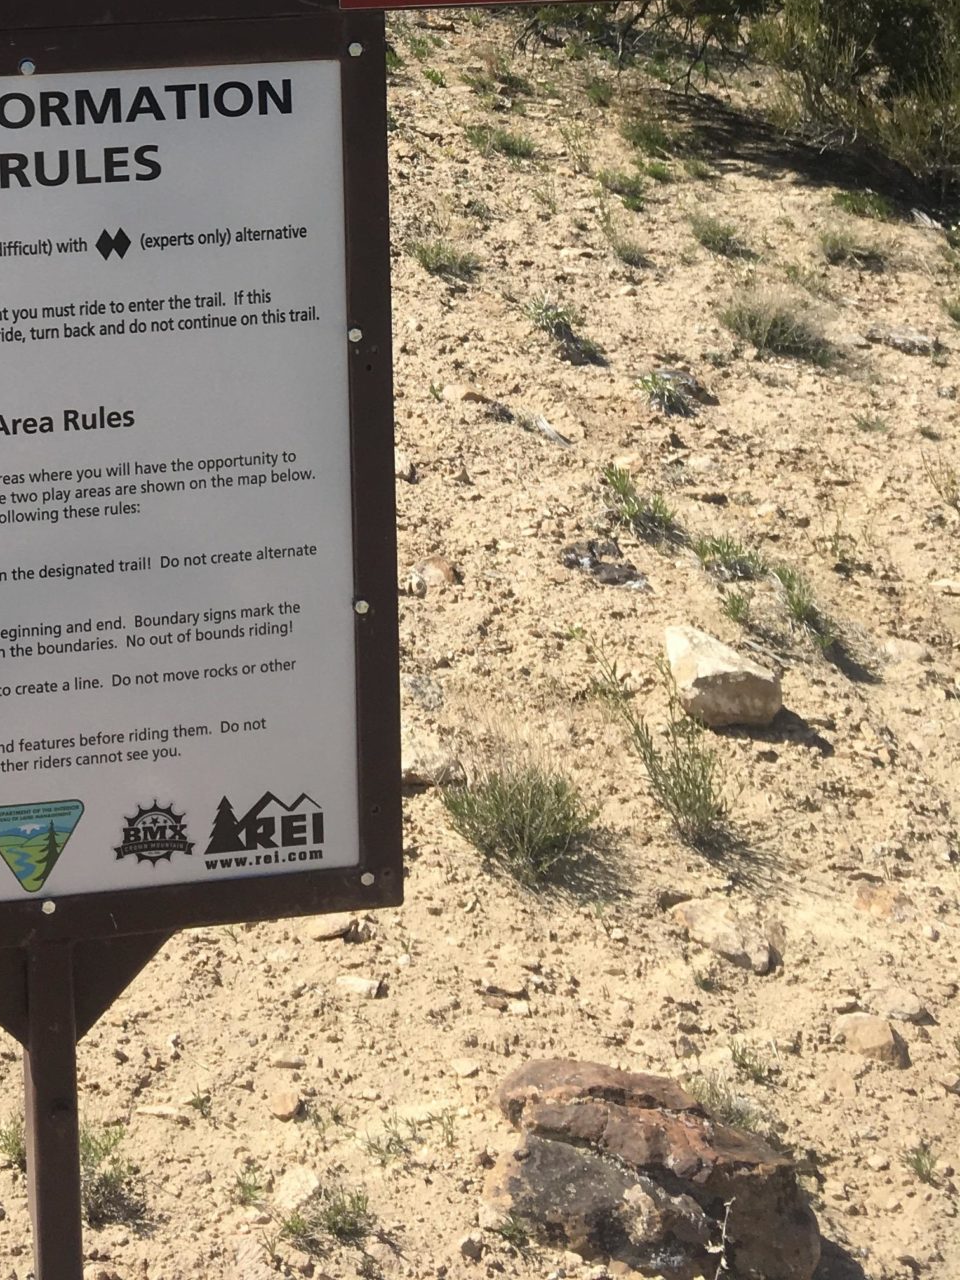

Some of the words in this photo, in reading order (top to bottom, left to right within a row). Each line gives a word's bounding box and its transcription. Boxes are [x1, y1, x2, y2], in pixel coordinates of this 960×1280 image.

[55, 236, 88, 254] with
[139, 231, 195, 252] (experts
[197, 227, 232, 248] only)
[234, 223, 308, 243] alternative
[63, 405, 136, 432] Rules
[122, 824, 188, 845] BMX
[245, 812, 324, 850] REI
[205, 849, 324, 870] www.rei.com
